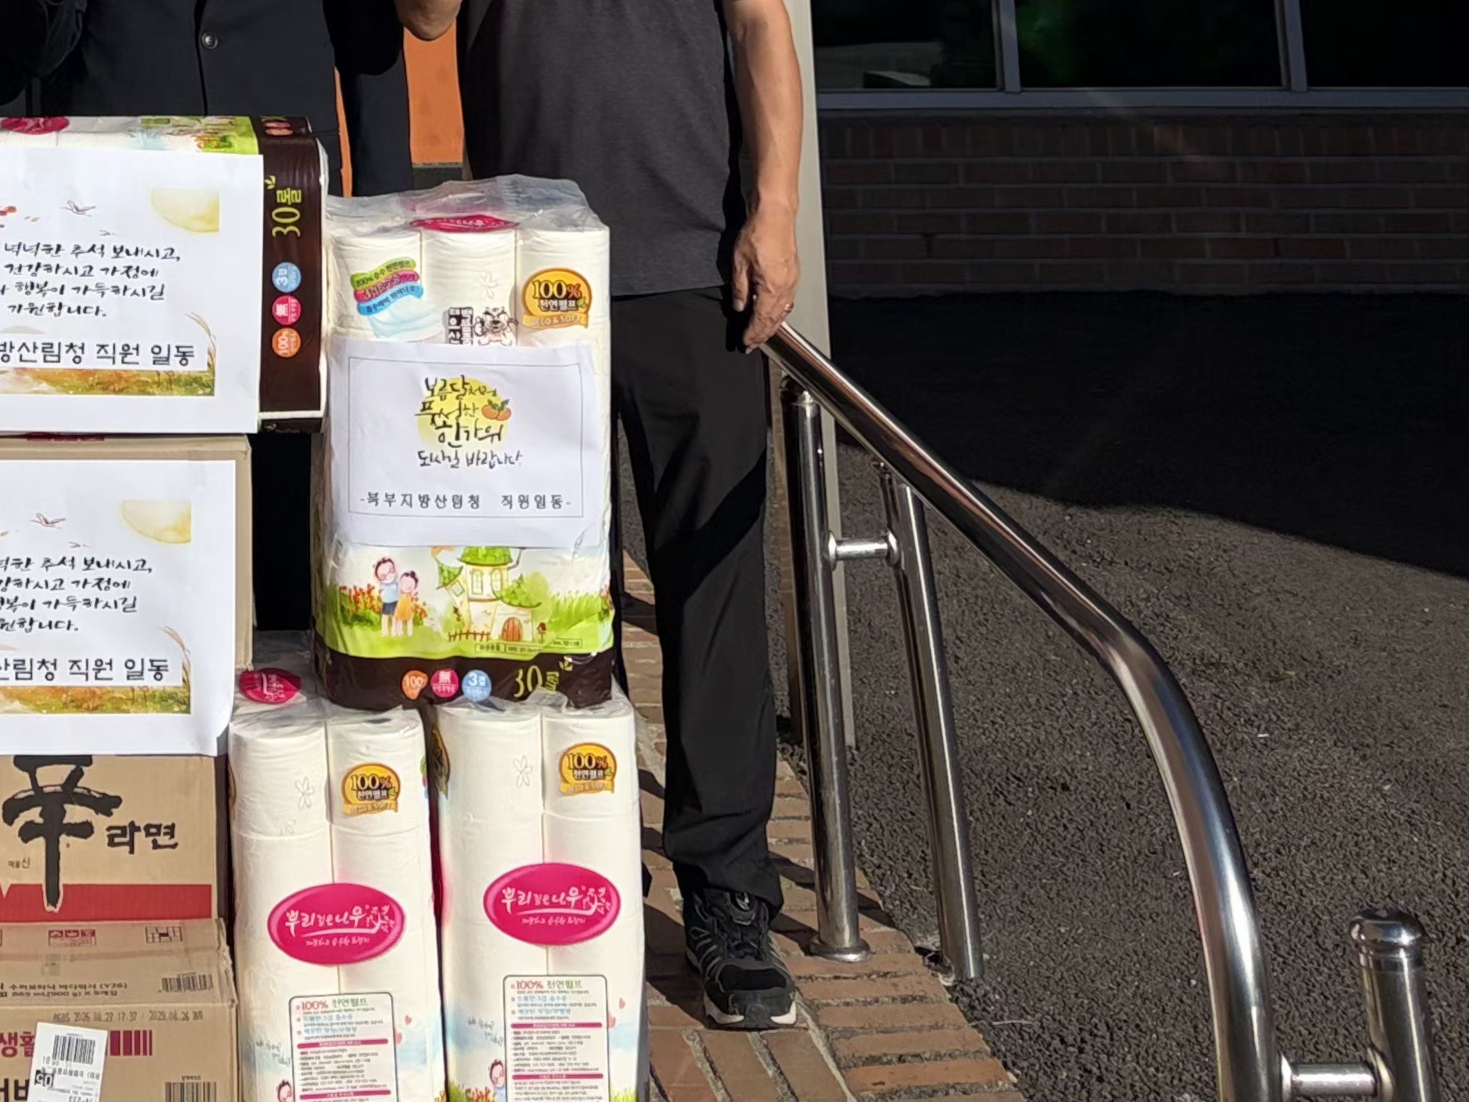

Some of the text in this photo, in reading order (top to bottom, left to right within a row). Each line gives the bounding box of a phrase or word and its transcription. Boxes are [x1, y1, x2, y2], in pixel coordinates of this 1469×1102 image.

[271, 188, 301, 238] 30롤
[3, 241, 64, 258] 넉넉한
[70, 242, 106, 259] 추석
[3, 261, 94, 279] 건강하시고
[100, 264, 159, 280] 가정에
[14, 281, 64, 298] 행복이
[71, 282, 165, 301] 가득하시길
[533, 281, 582, 298] 100%
[95, 341, 140, 366] 직원
[150, 342, 195, 367] 일동
[425, 375, 498, 400] 보름달처럼
[414, 401, 477, 425] 풍성한
[434, 418, 502, 448] 한가위
[466, 450, 523, 469] 바랍니다
[40, 557, 76, 573] 추석
[70, 577, 131, 592] 가정에
[41, 596, 138, 614] 가득하시길
[67, 658, 114, 681] 직원
[123, 658, 170, 682] 일동
[567, 754, 608, 769] 100%
[351, 774, 391, 790] 100%
[106, 820, 178, 854] 라면
